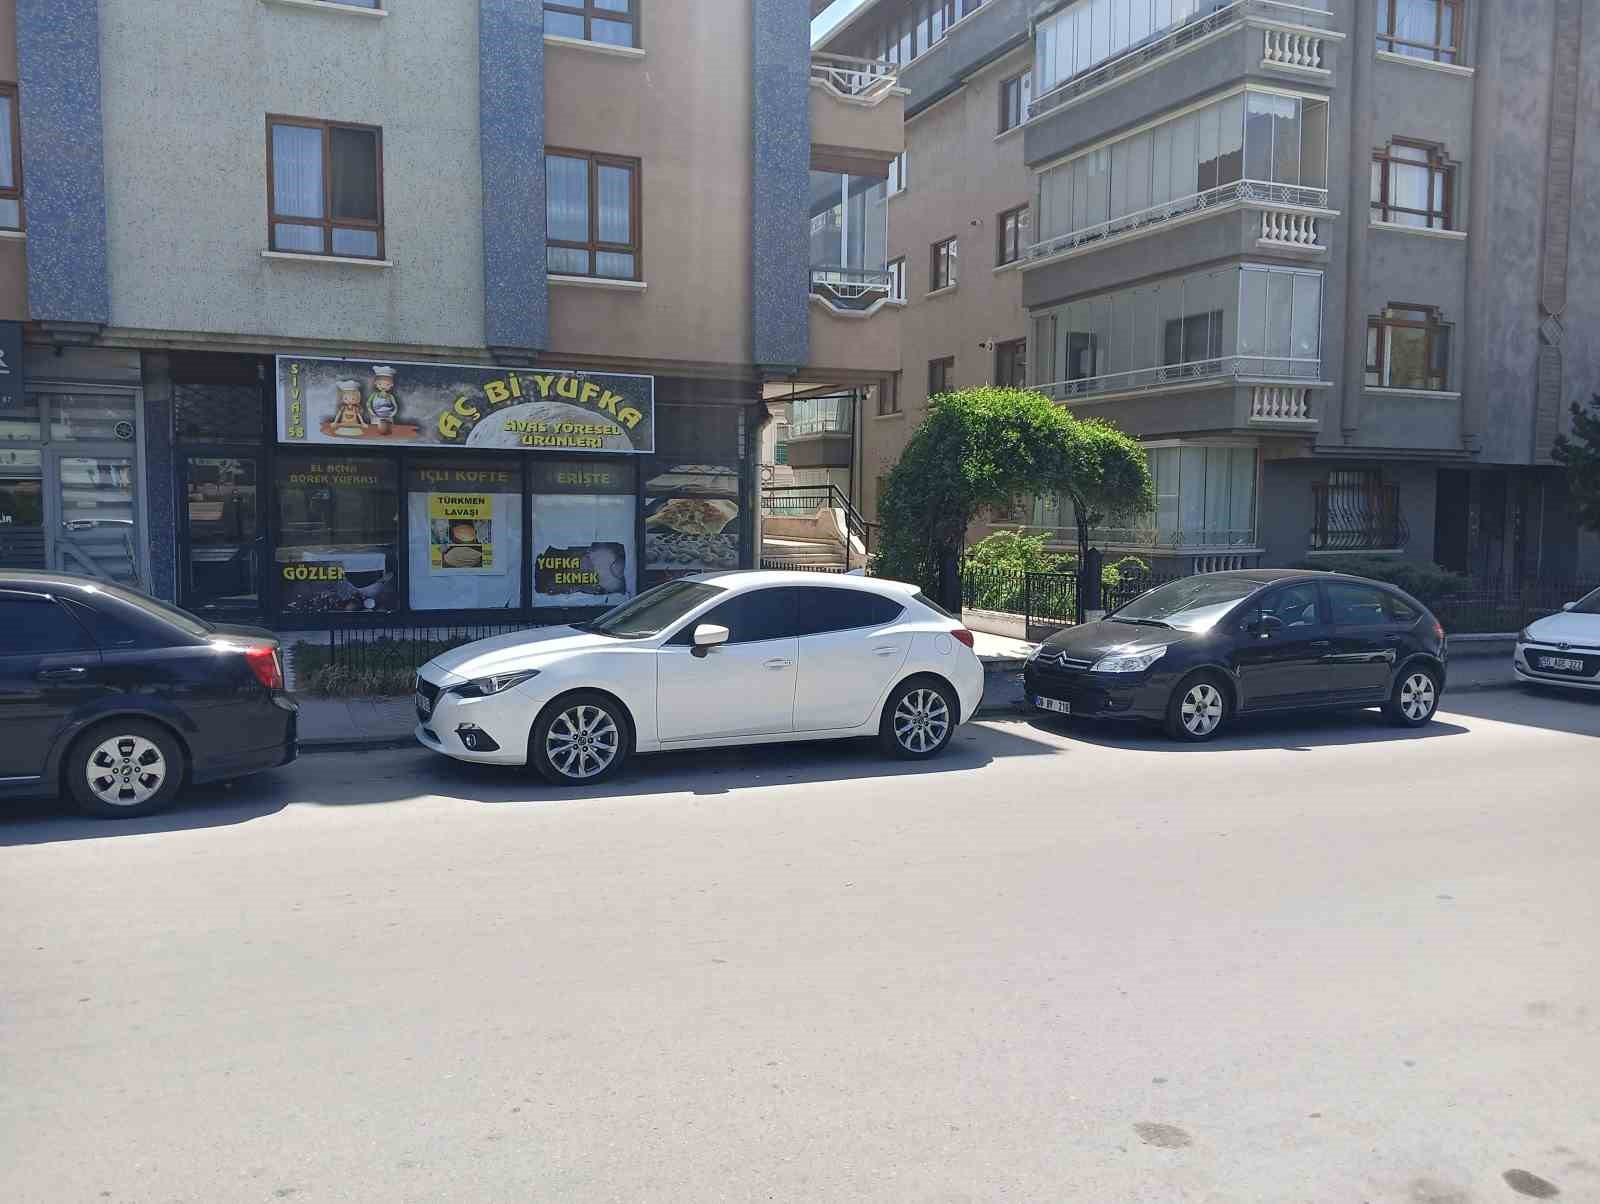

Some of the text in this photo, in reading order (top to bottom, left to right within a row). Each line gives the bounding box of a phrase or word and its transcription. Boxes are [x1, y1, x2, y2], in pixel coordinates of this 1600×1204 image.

[438, 396, 480, 438] AÇ
[483, 372, 521, 403] Bİ
[537, 557, 580, 570] YUFKA
[555, 572, 599, 585] EKMEK
